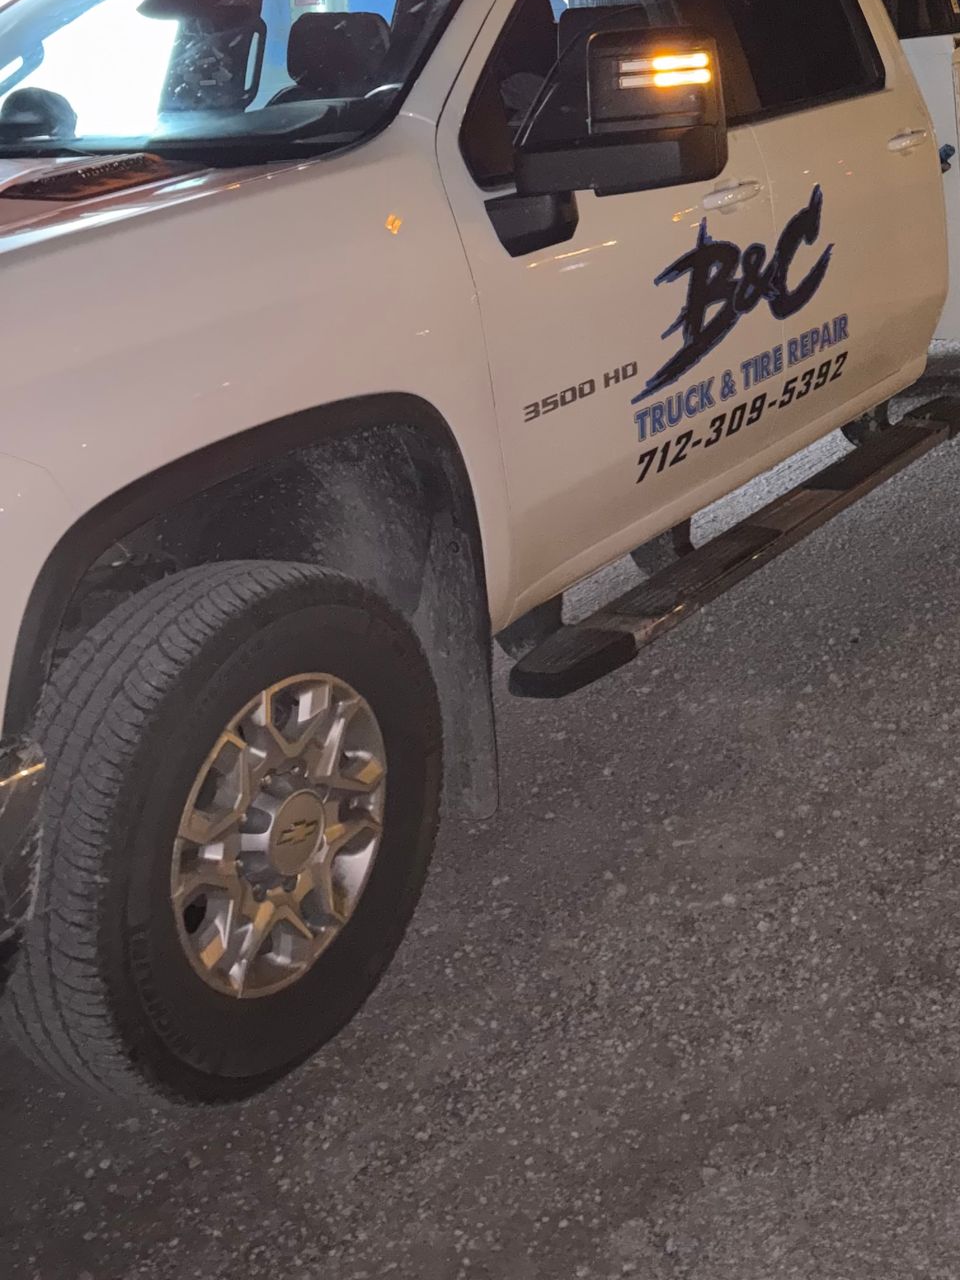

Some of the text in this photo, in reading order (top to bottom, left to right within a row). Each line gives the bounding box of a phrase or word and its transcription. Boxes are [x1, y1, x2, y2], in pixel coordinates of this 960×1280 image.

[630, 183, 835, 405] B&C
[522, 361, 638, 423] 3500 HD
[633, 313, 850, 443] TRUCK & TIRE REPAIR
[635, 351, 849, 484] 712-309-5392
